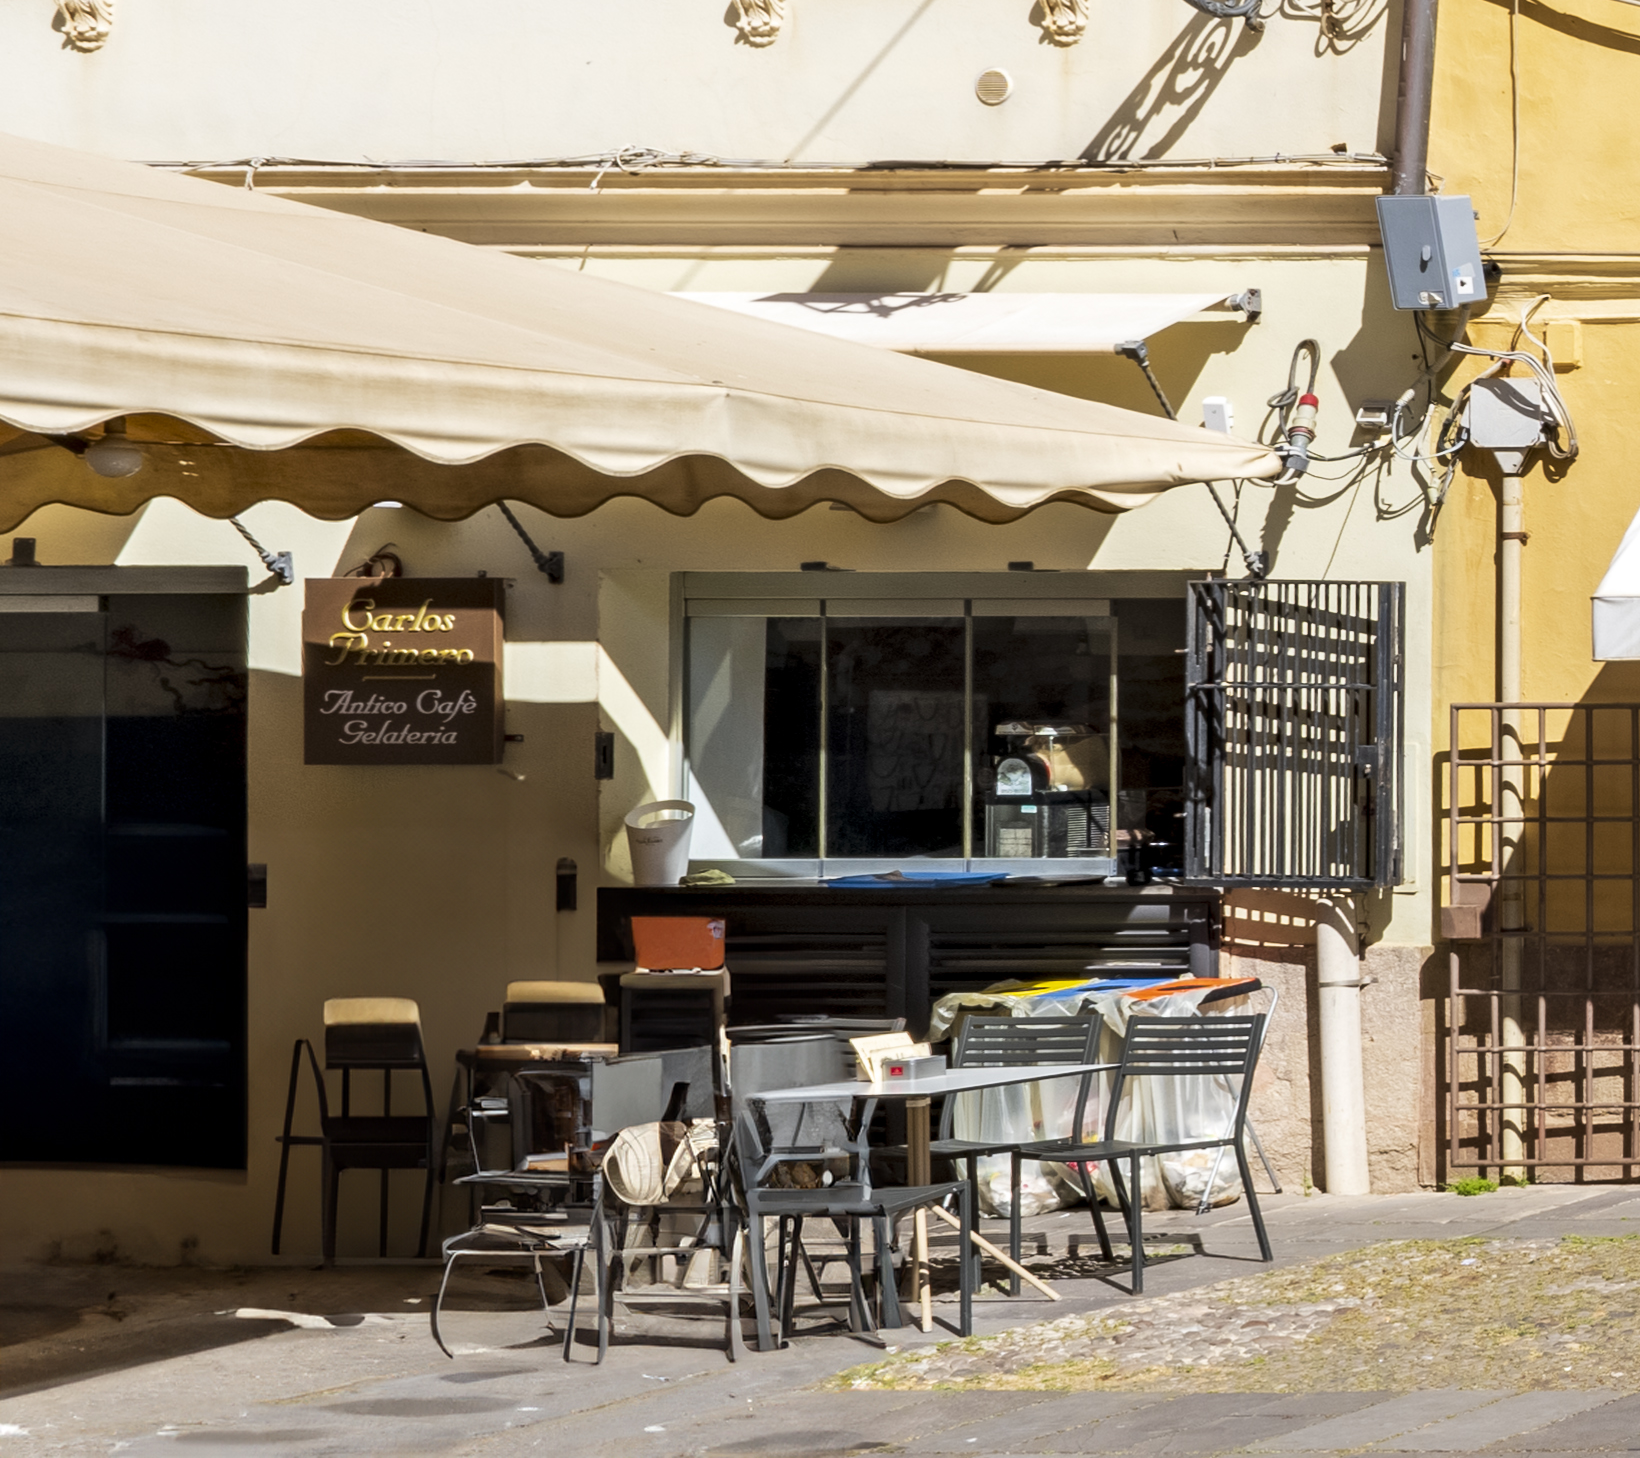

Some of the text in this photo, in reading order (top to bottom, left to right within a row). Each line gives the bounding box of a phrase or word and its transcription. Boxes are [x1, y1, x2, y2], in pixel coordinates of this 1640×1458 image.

[341, 598, 456, 632] Carlos
[324, 632, 475, 666] Primero
[320, 689, 478, 723] Antico Cafè
[338, 720, 458, 745] Gelateria
